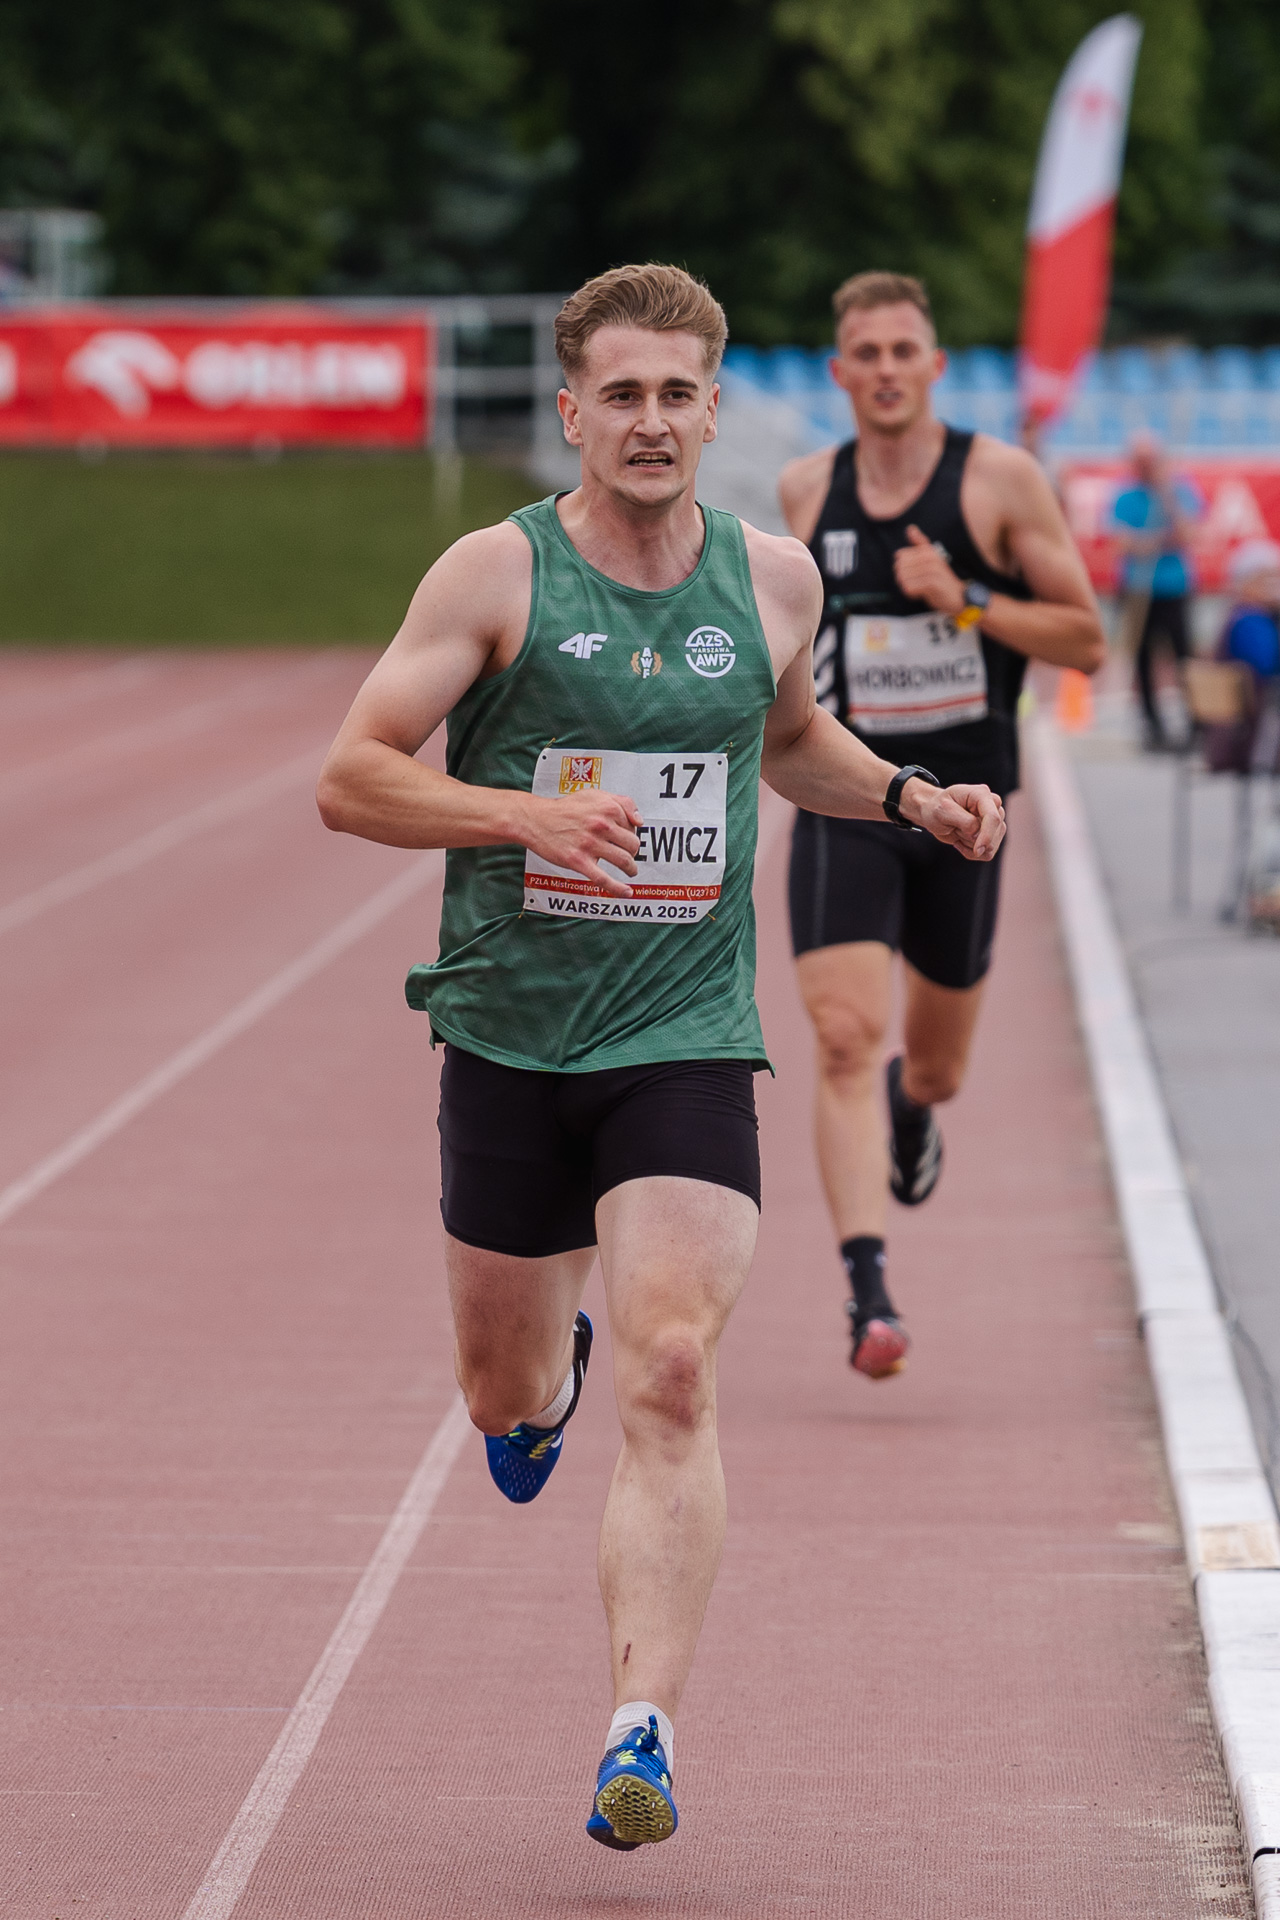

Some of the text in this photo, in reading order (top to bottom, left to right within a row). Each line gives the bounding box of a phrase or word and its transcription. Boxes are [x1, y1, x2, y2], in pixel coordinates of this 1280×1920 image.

[558, 632, 608, 659] 4F
[695, 634, 724, 647] AZS
[696, 653, 729, 667] AWF
[659, 763, 706, 799] 17
[634, 826, 718, 863] EWICZ
[529, 876, 549, 886] PZLA
[550, 880, 600, 892] Mistrzostwa
[635, 887, 685, 898] wielobojach
[548, 897, 697, 919] WARSZAWA 2025
